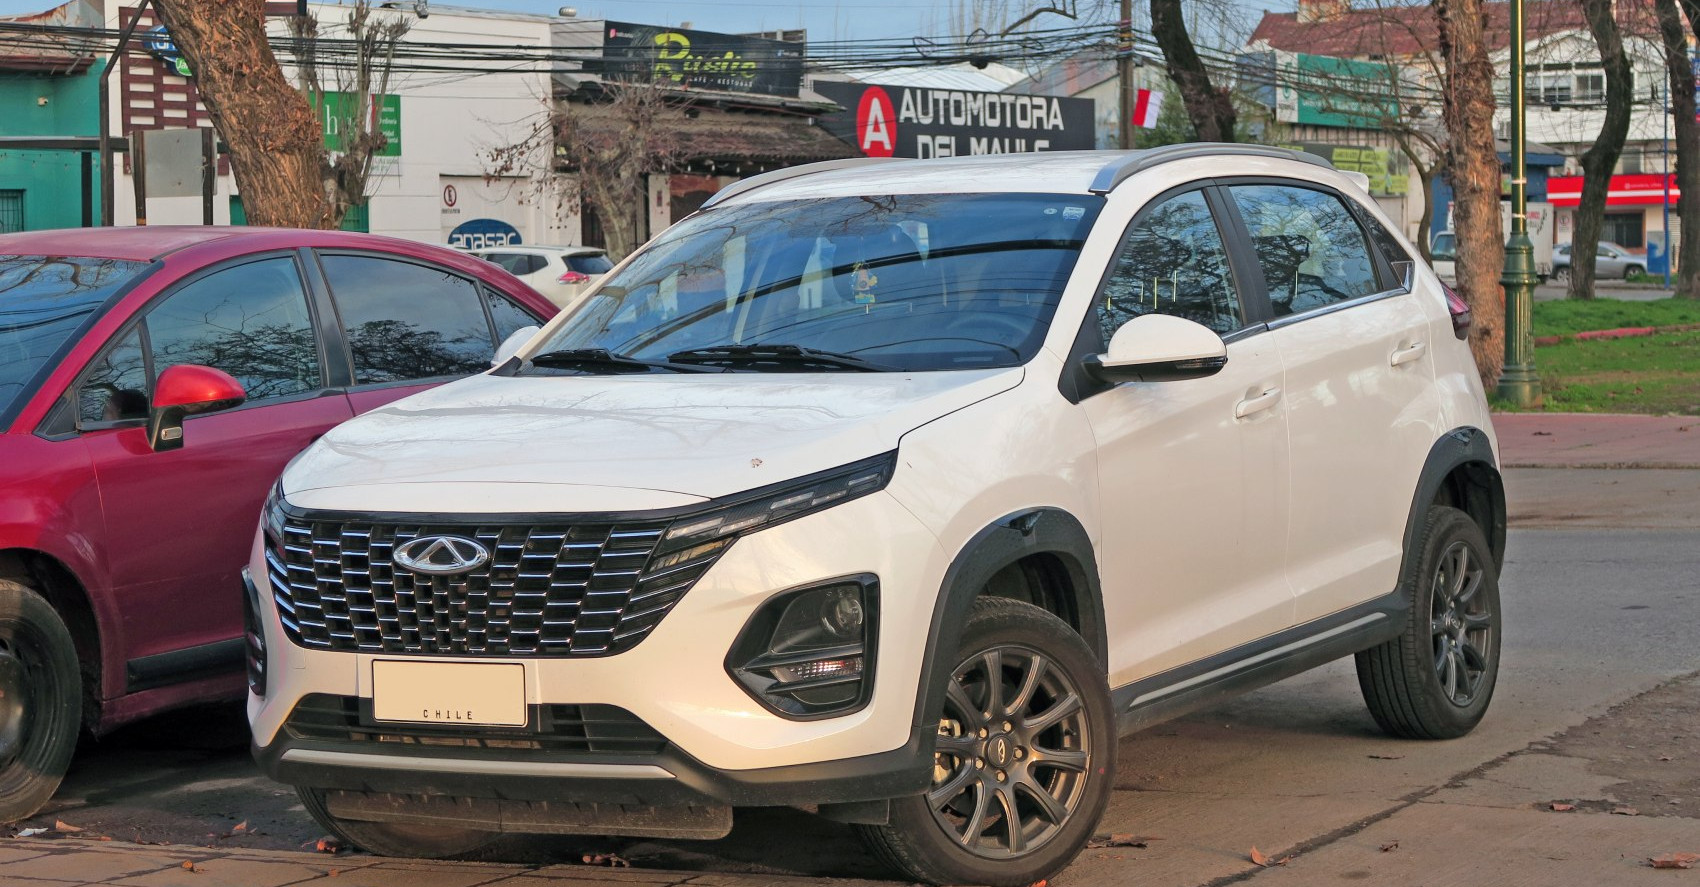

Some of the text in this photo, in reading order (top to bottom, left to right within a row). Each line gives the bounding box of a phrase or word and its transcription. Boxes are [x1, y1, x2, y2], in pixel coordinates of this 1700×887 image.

[863, 97, 892, 150] A
[899, 88, 1065, 131] AUTOMOTORA
[423, 709, 473, 720] CHILE
